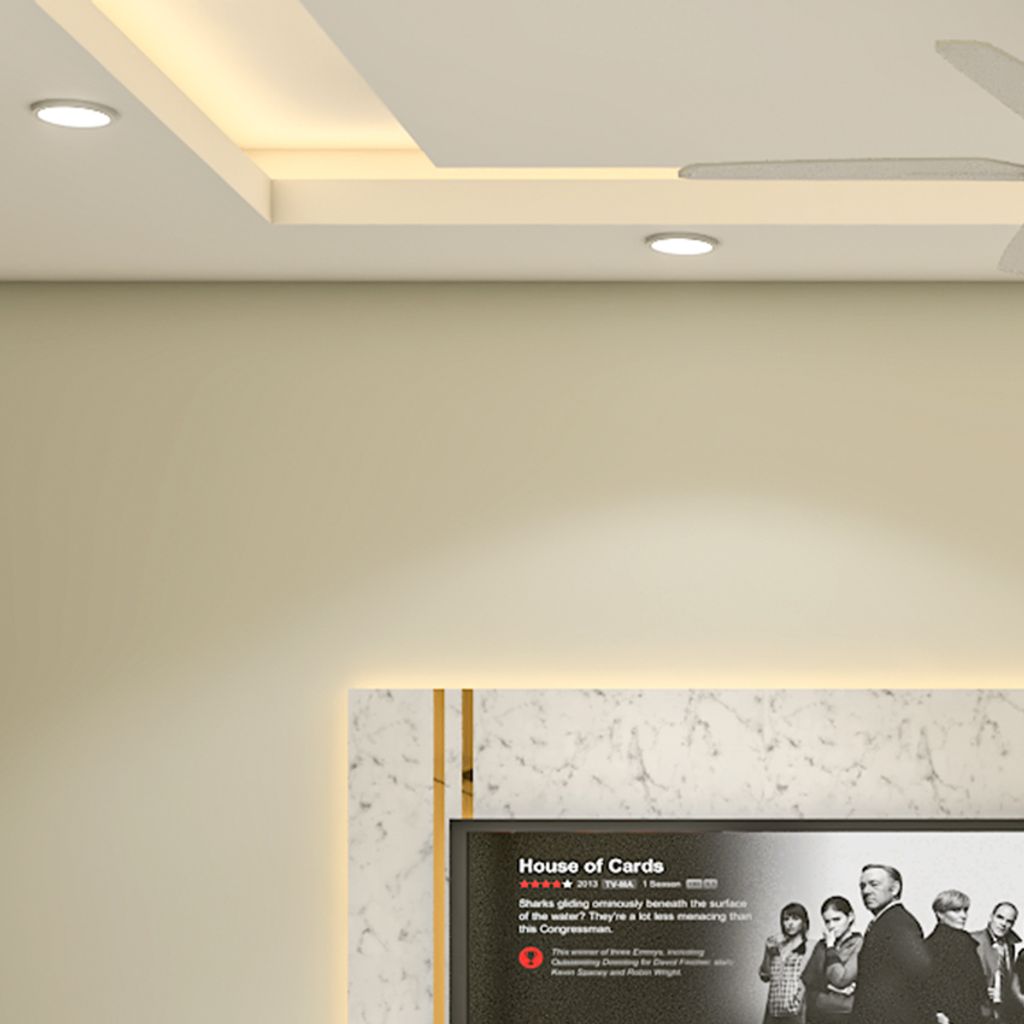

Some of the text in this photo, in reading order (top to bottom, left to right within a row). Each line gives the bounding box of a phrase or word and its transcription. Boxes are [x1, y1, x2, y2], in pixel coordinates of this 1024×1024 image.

[519, 858, 665, 873] House of Cards
[577, 880, 598, 889] 2013
[519, 899, 554, 908] Sharks
[557, 899, 589, 910] gliding
[646, 899, 688, 908] beneath
[690, 899, 707, 908] the
[709, 899, 748, 908] surface
[519, 911, 529, 920] of
[531, 911, 548, 920] the
[551, 911, 586, 920] water?
[589, 911, 626, 923] They're
[639, 912, 651, 920] lot
[729, 912, 752, 920] than
[519, 925, 537, 933] this
